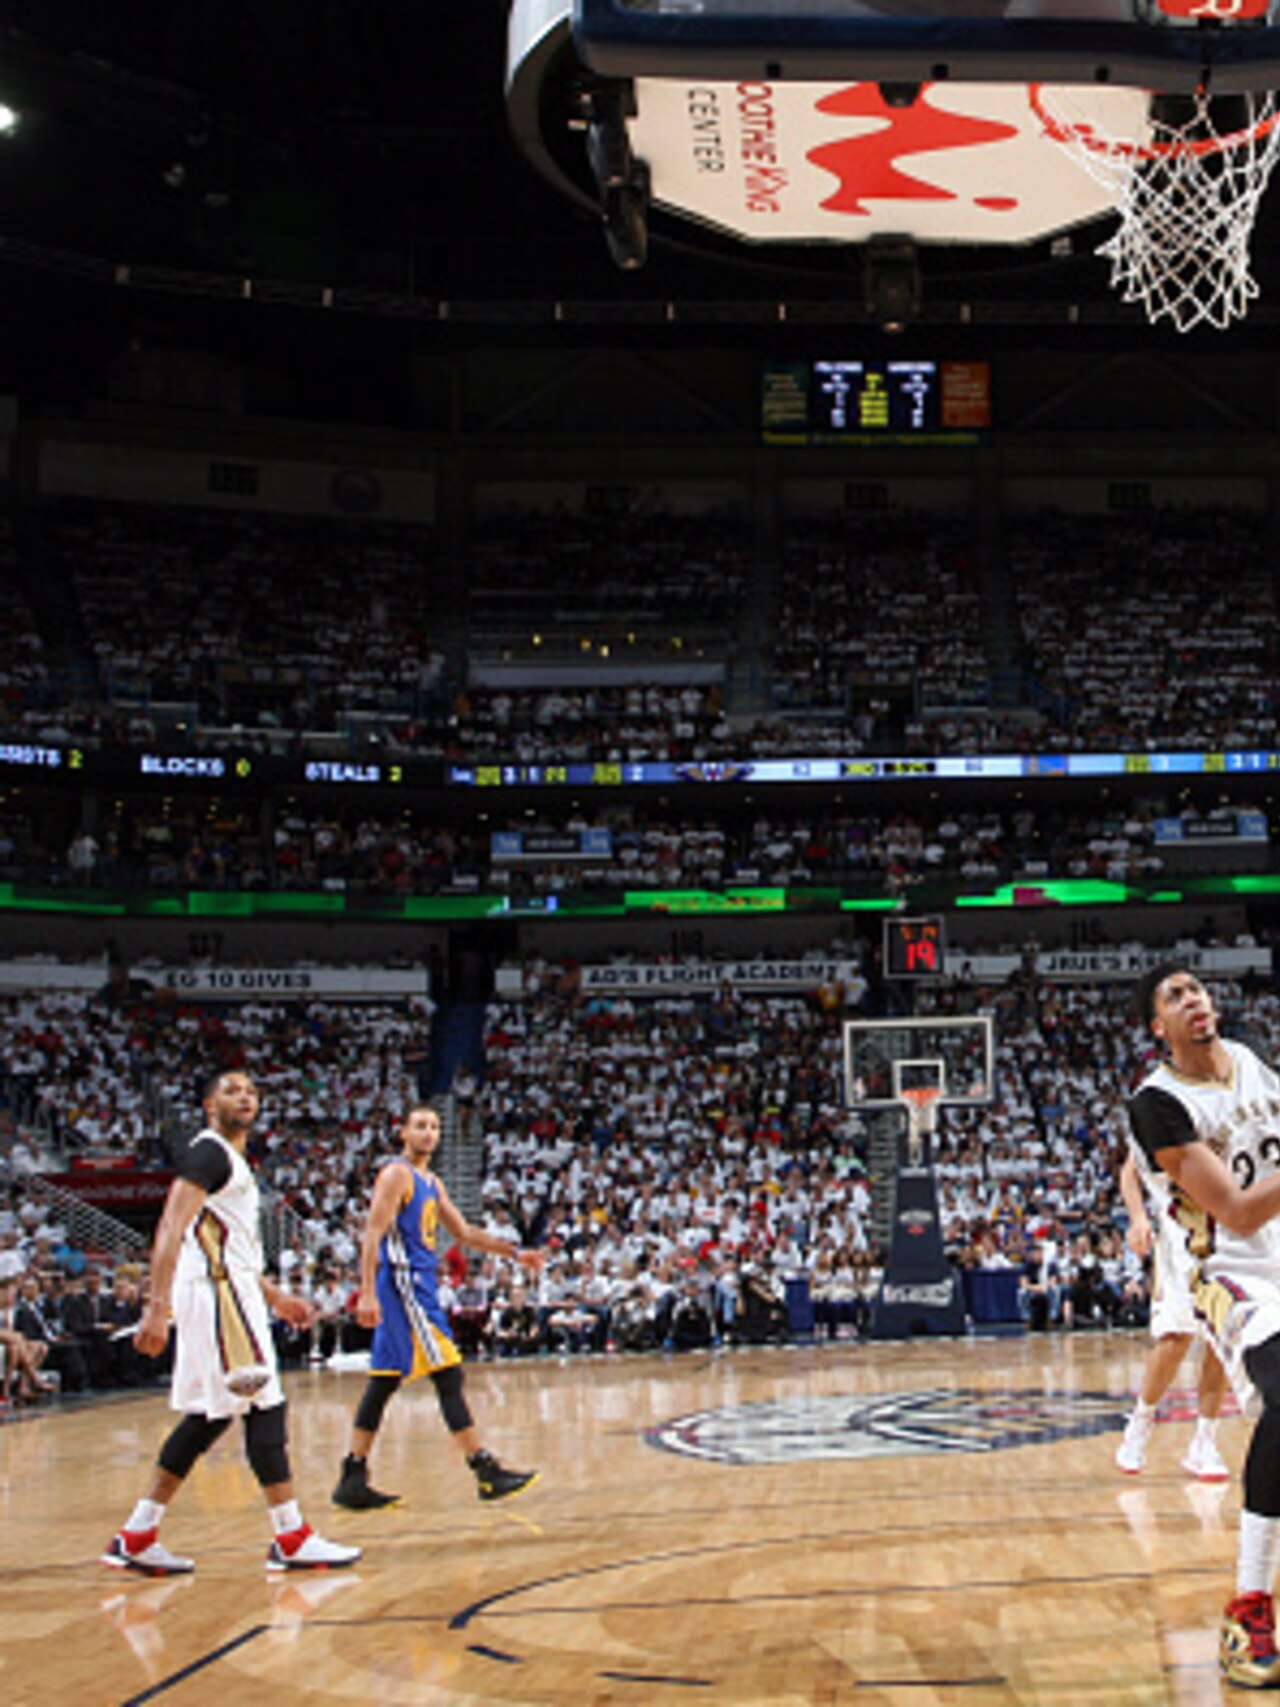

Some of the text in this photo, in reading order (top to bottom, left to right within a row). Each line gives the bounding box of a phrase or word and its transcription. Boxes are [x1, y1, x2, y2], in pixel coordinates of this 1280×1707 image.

[689, 88, 726, 174] CENTER
[140, 755, 225, 777] BLOCKS
[305, 762, 381, 783] STEALS
[207, 972, 233, 988] 10
[239, 972, 311, 988] GIVES
[646, 964, 725, 983] FLIGHT
[732, 962, 838, 982] ACADEMY
